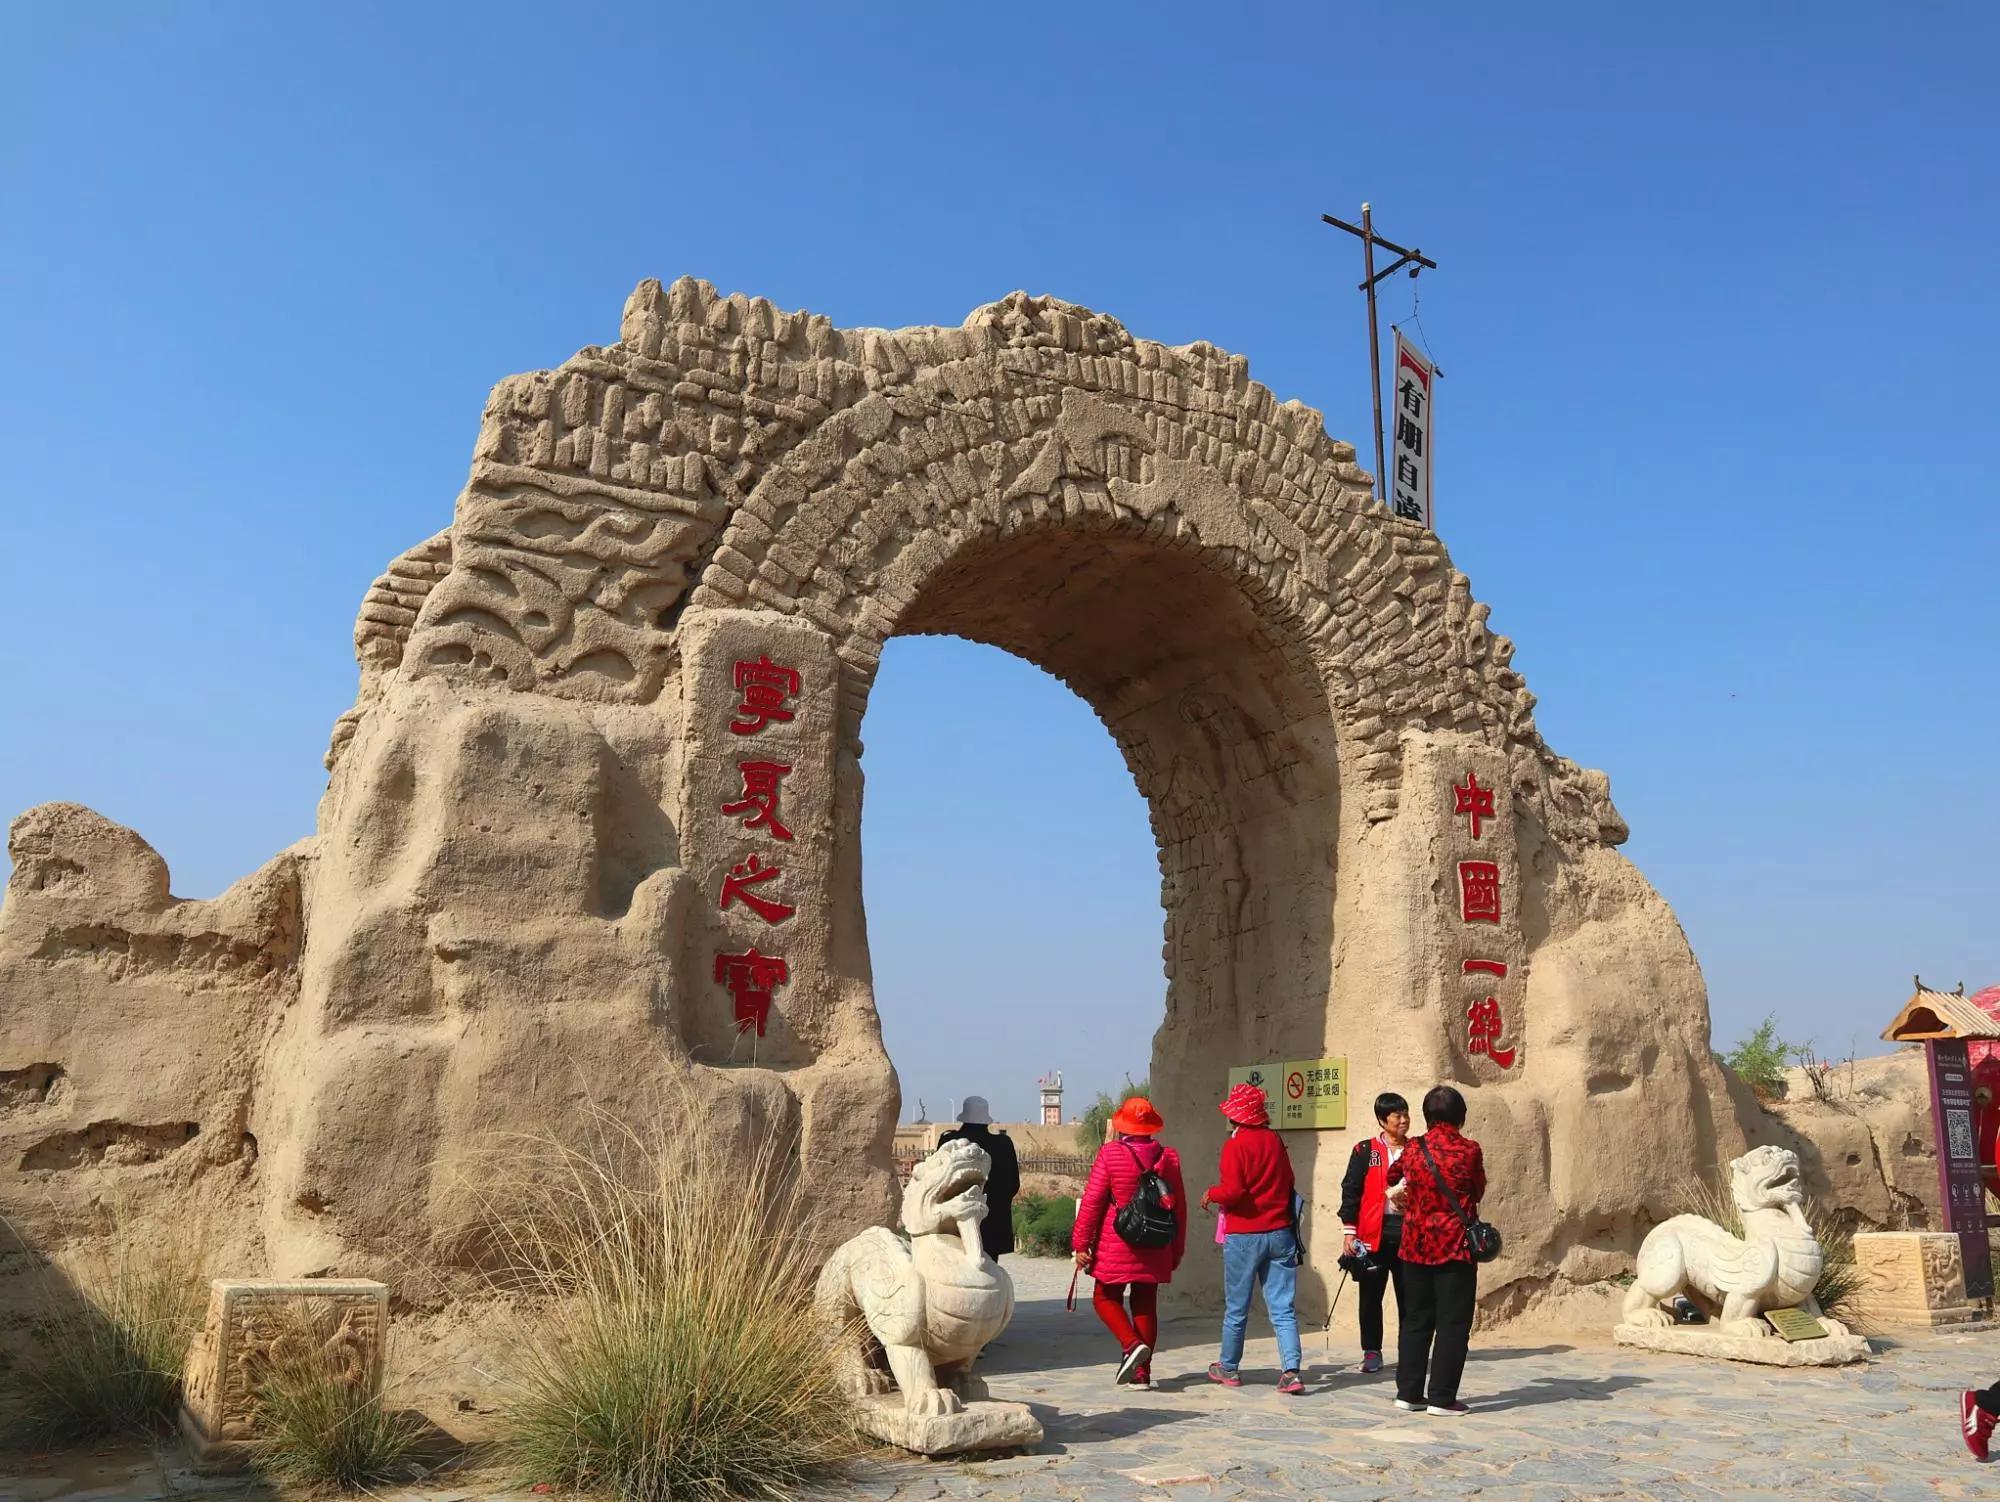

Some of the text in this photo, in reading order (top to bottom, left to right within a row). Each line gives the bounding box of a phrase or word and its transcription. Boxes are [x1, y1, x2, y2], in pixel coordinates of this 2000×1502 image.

[1306, 1069, 1340, 1082] 无烟景区
[1307, 1083, 1340, 1097] 禁止吸烟
